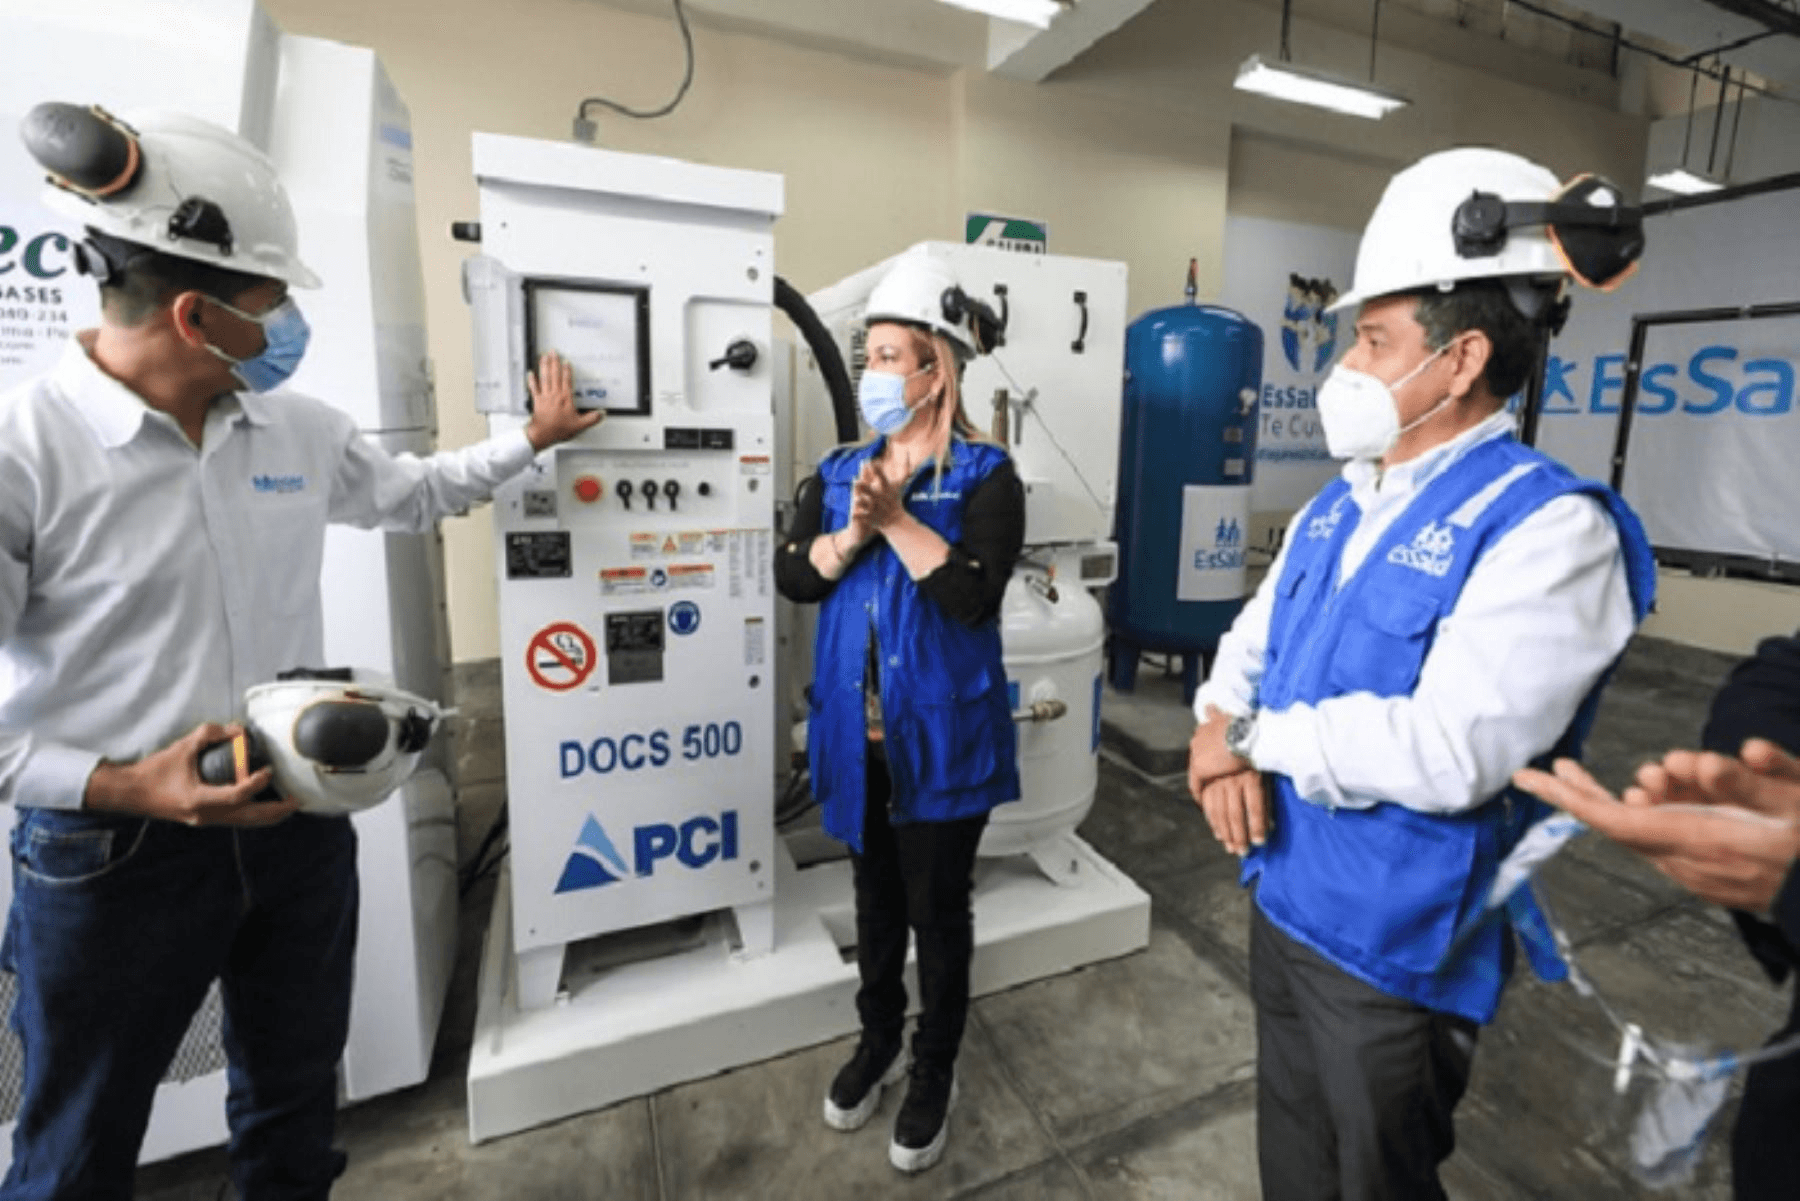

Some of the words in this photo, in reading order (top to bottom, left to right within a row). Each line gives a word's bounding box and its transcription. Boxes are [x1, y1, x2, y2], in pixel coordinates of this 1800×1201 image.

[0, 286, 62, 304] ASES
[1590, 346, 1800, 415] EsSa
[1263, 413, 1283, 437] Te
[559, 728, 671, 778] DOCS
[682, 720, 743, 761] 500
[633, 809, 739, 877] PCI
